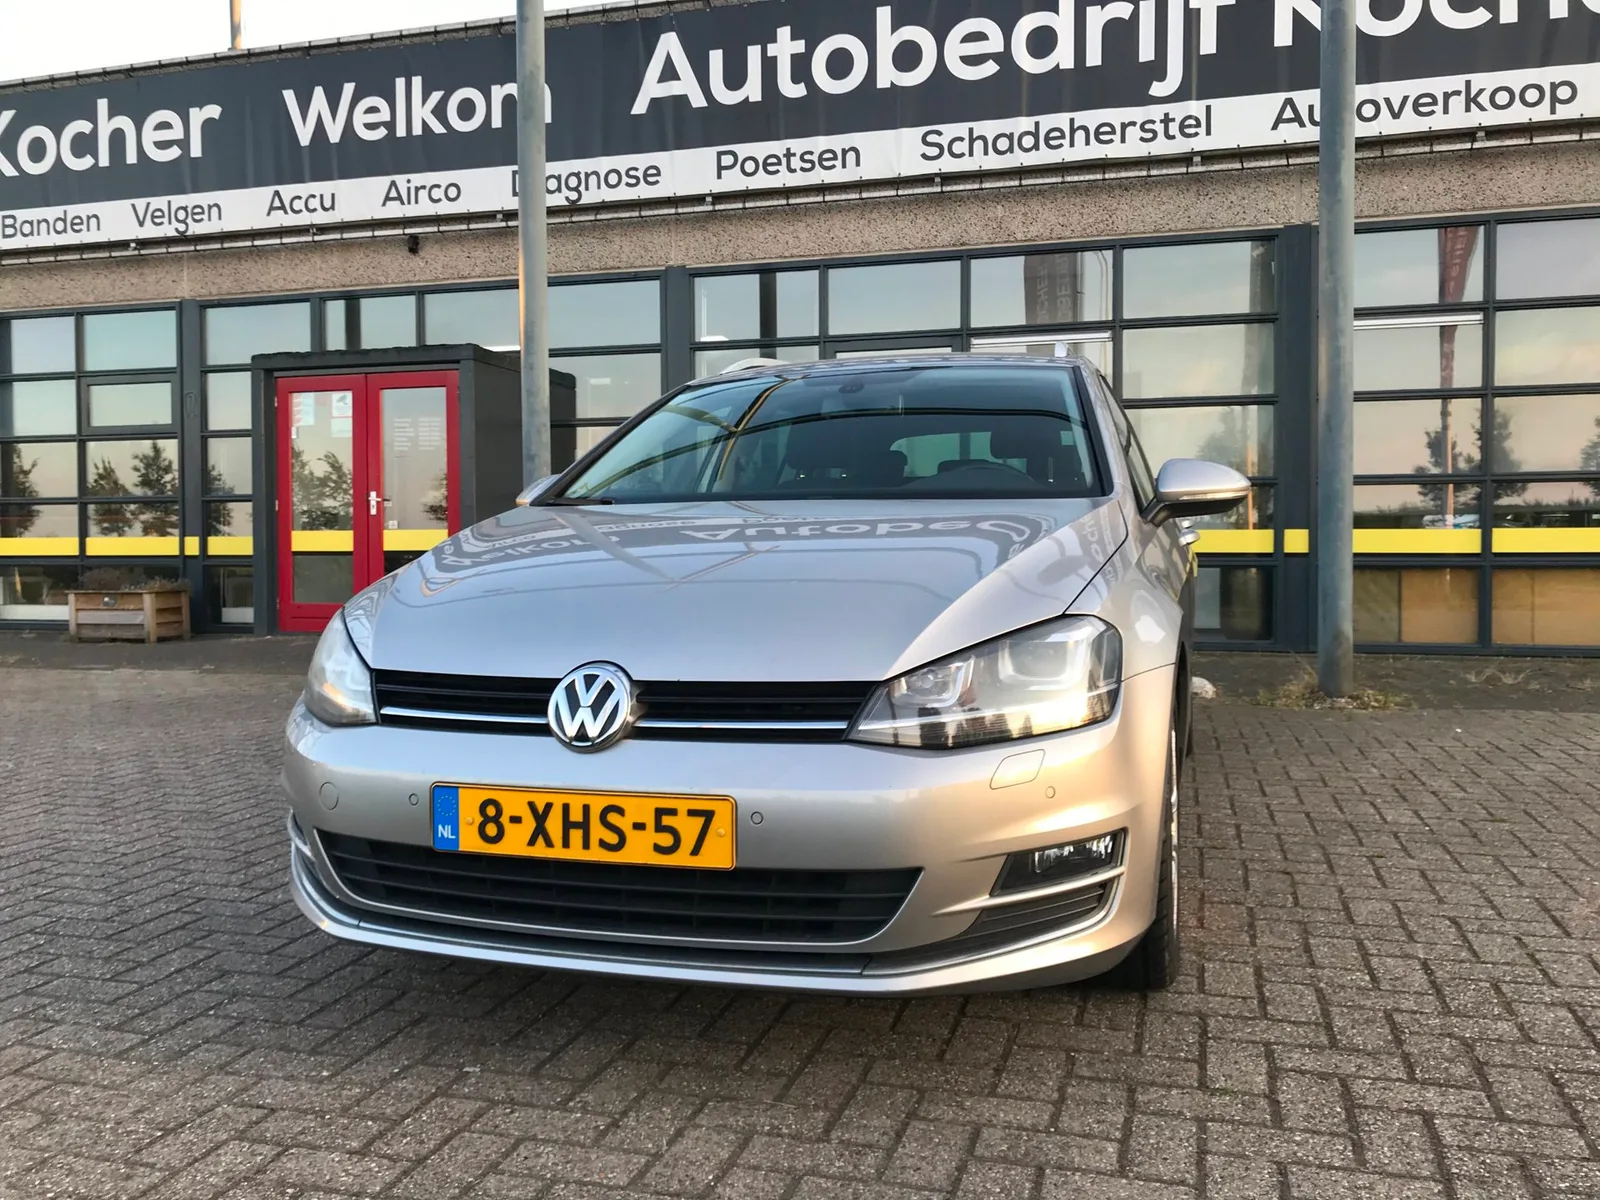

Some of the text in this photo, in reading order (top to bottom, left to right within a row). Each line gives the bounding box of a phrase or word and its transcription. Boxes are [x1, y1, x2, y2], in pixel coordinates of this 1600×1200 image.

[1, 80, 1578, 239] Banden Velgen Accu Airco agnose Poetsen Schadeherstel Auoverkoop
[548, 664, 632, 748] VW
[437, 824, 456, 839] NL
[477, 798, 716, 857] 8-XHS-57
